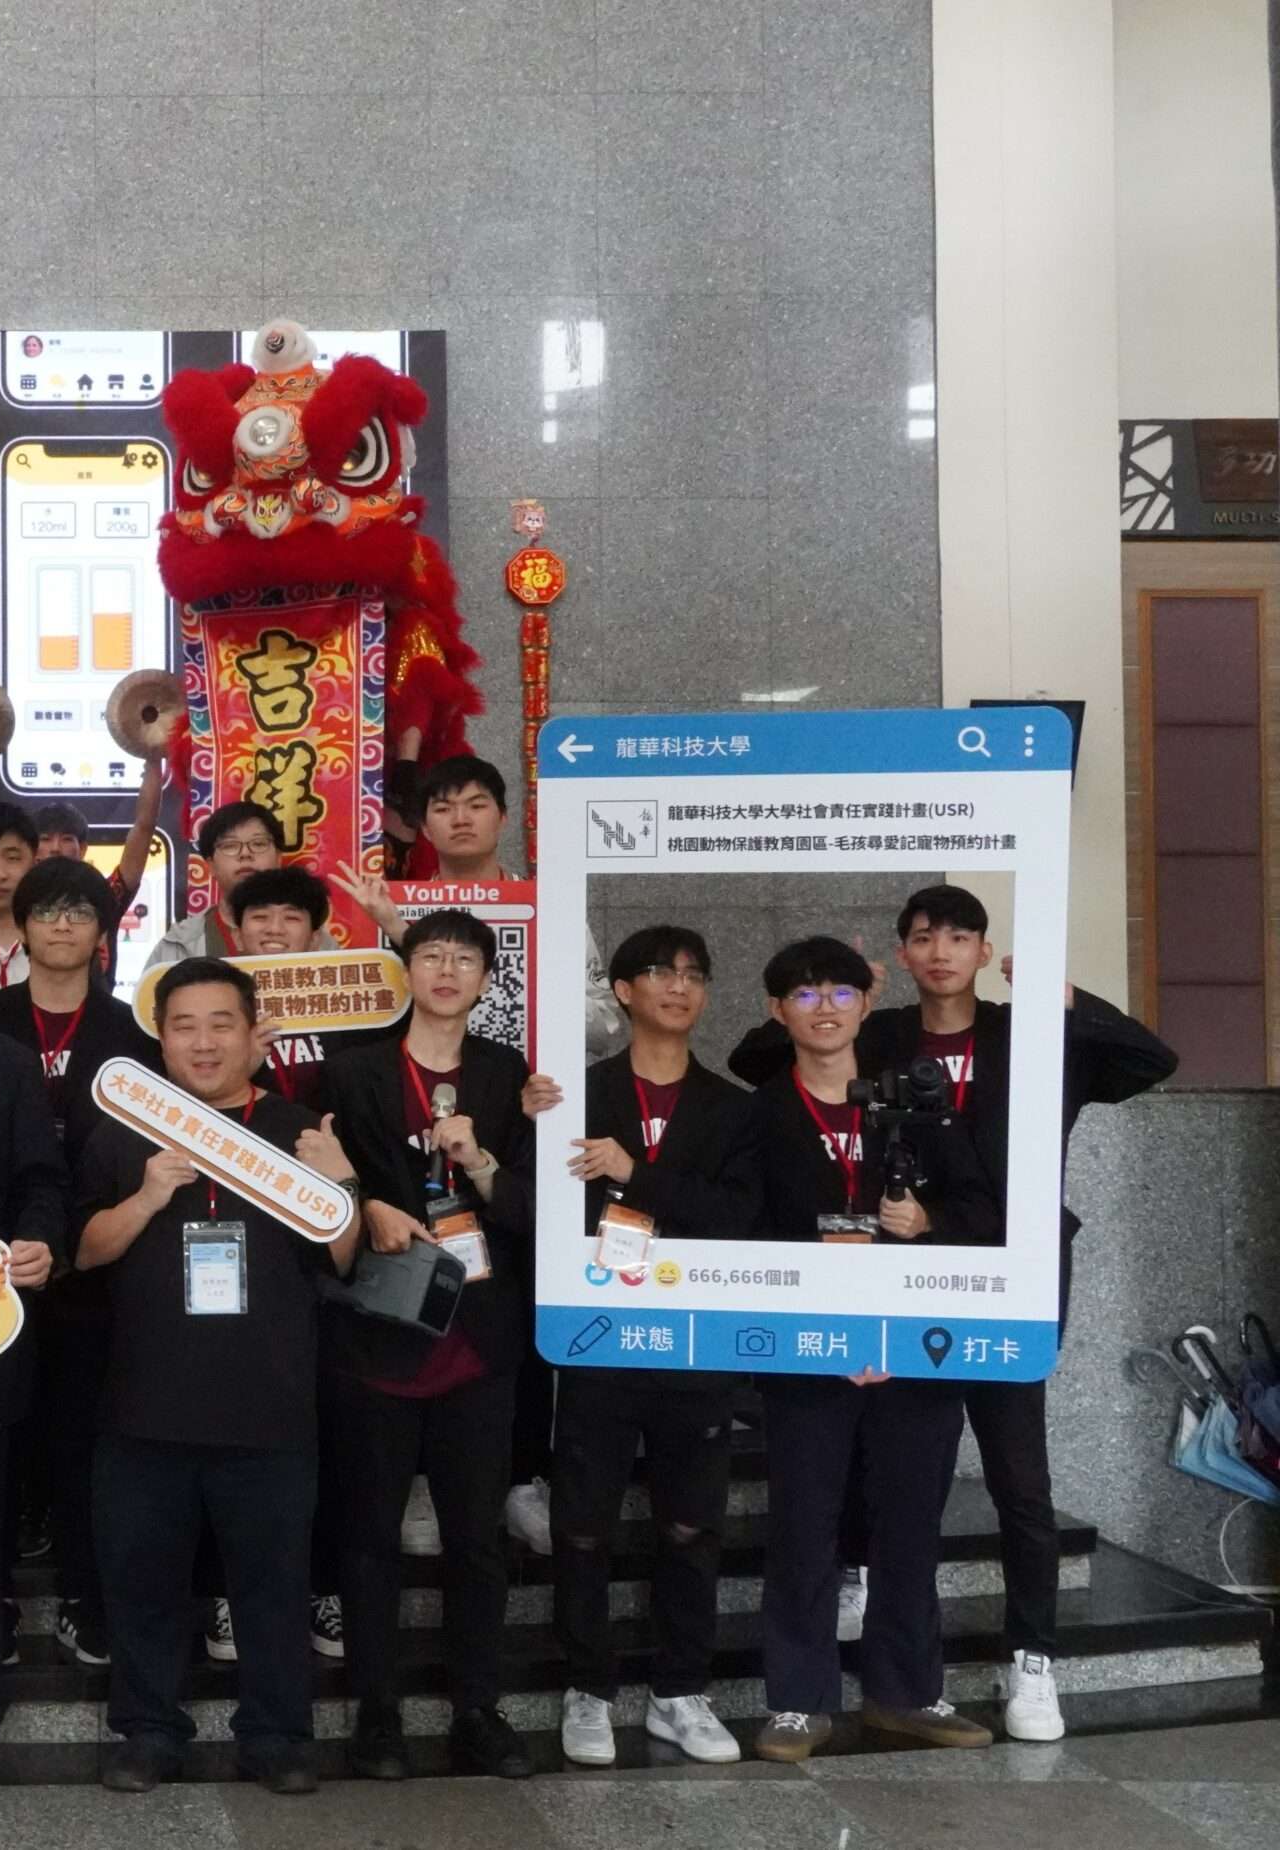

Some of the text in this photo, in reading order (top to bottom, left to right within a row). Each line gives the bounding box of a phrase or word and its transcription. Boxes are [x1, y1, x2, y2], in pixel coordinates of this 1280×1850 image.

[107, 521, 138, 534] 200g
[521, 558, 552, 588] 福
[236, 629, 324, 852] 吉祥
[616, 735, 751, 758] 龍華科技大學
[403, 884, 500, 901] YouTube
[106, 1072, 338, 1222] 大學社會責任實踐計畫 USR
[688, 1268, 801, 1287] 666,666個讚
[903, 1275, 1008, 1293] 1000則留言
[620, 1325, 674, 1351] 狀態
[797, 1332, 848, 1358] 照片
[963, 1336, 1020, 1364] 打卡
